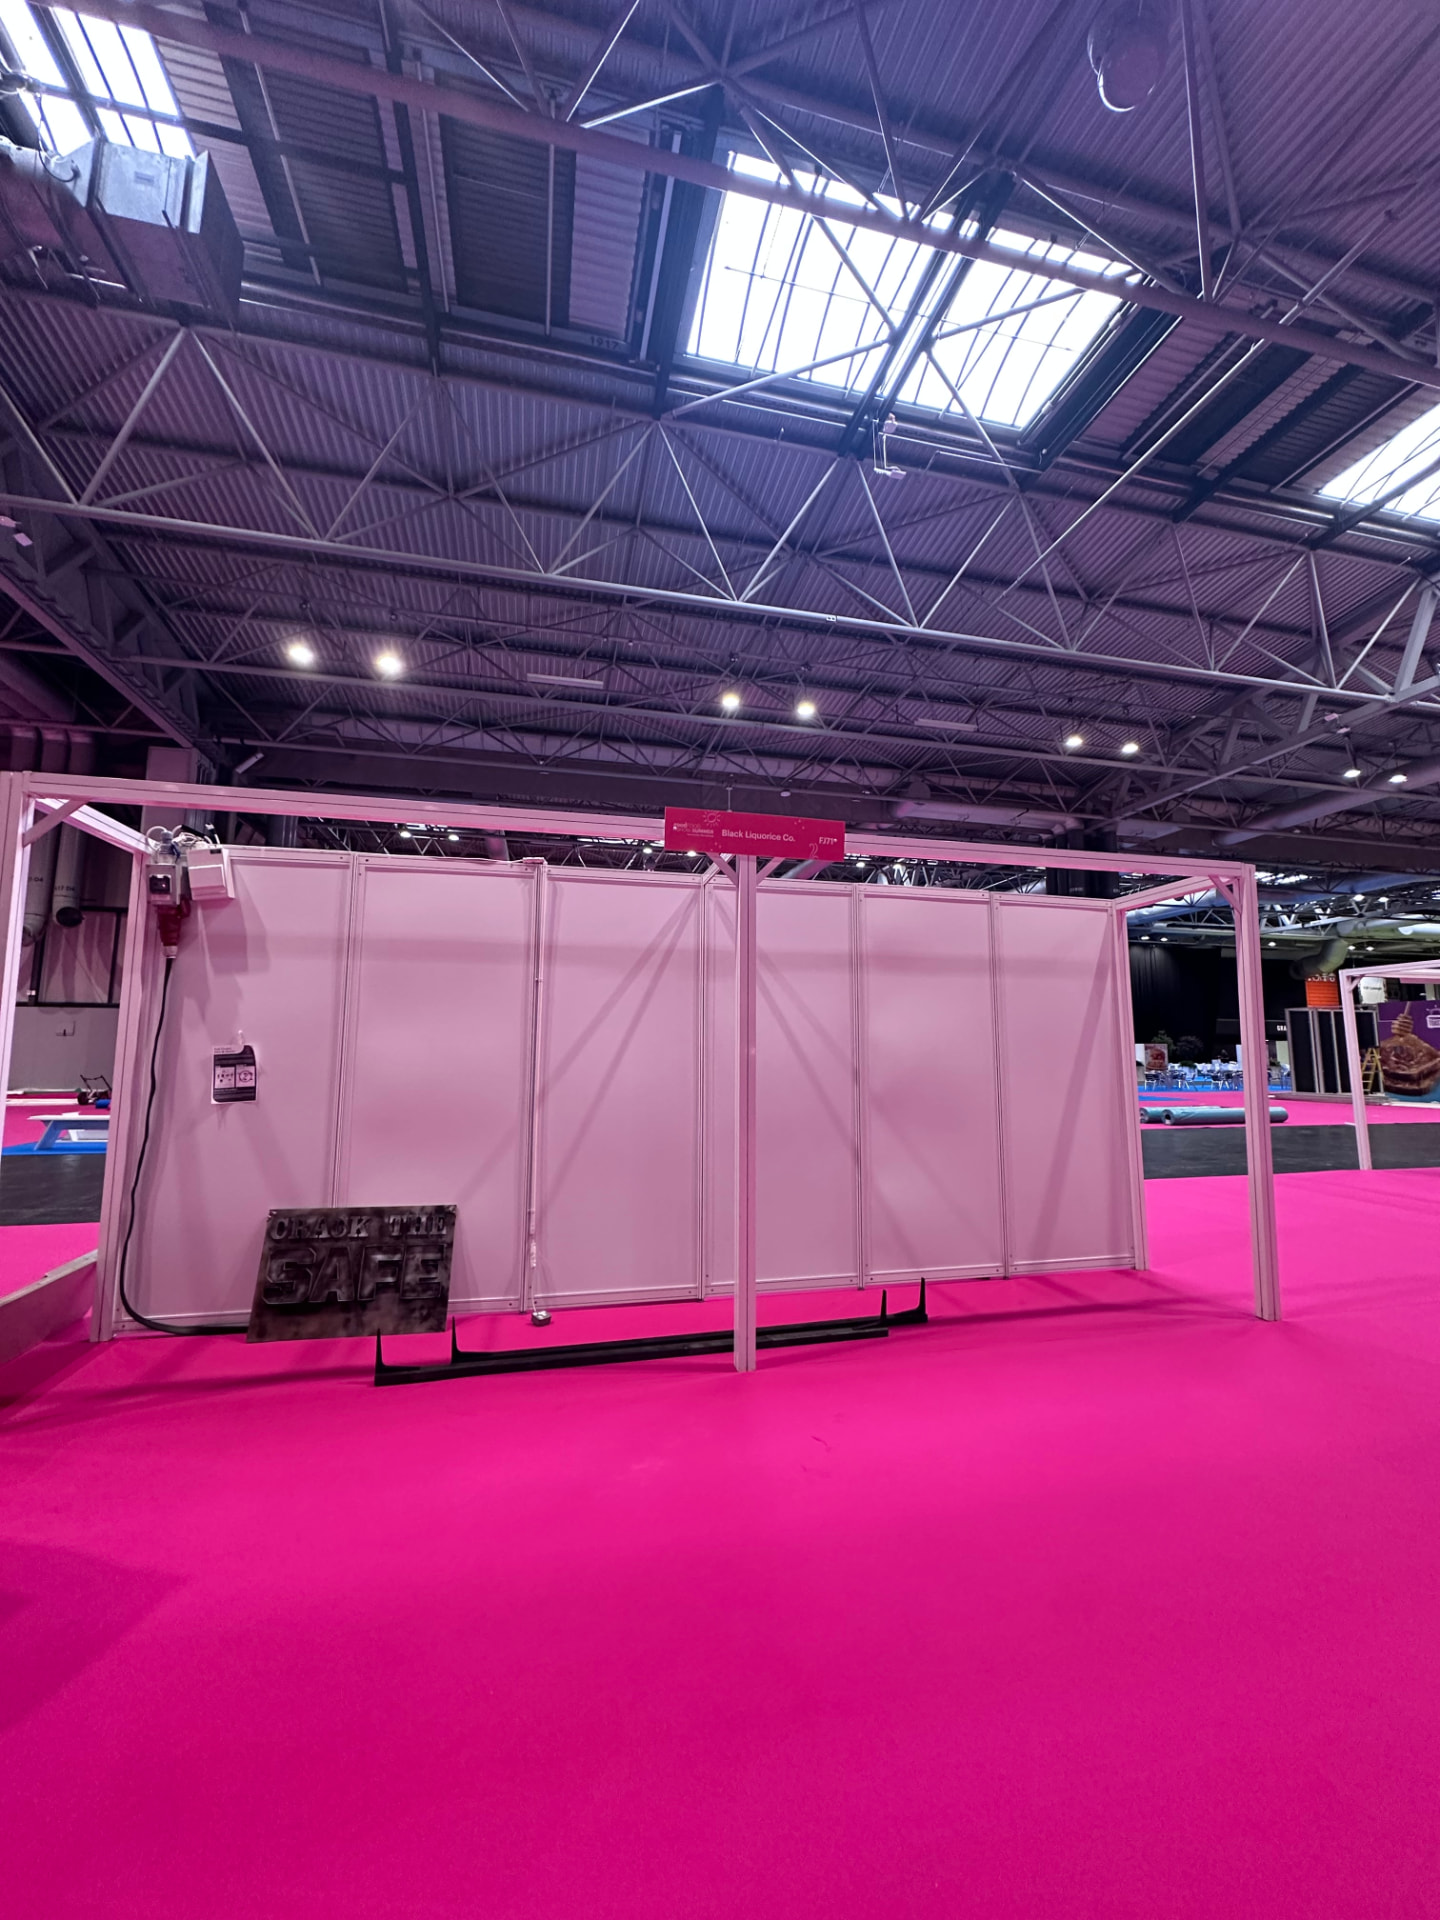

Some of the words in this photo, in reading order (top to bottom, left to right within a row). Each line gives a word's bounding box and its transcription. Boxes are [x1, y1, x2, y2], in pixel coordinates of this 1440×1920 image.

[722, 829, 743, 838] Black
[745, 831, 781, 841] Liquorice
[782, 833, 796, 842] Co.
[270, 1215, 371, 1240] CRACK
[385, 1214, 448, 1236] THE
[262, 1244, 447, 1305] SAFE
